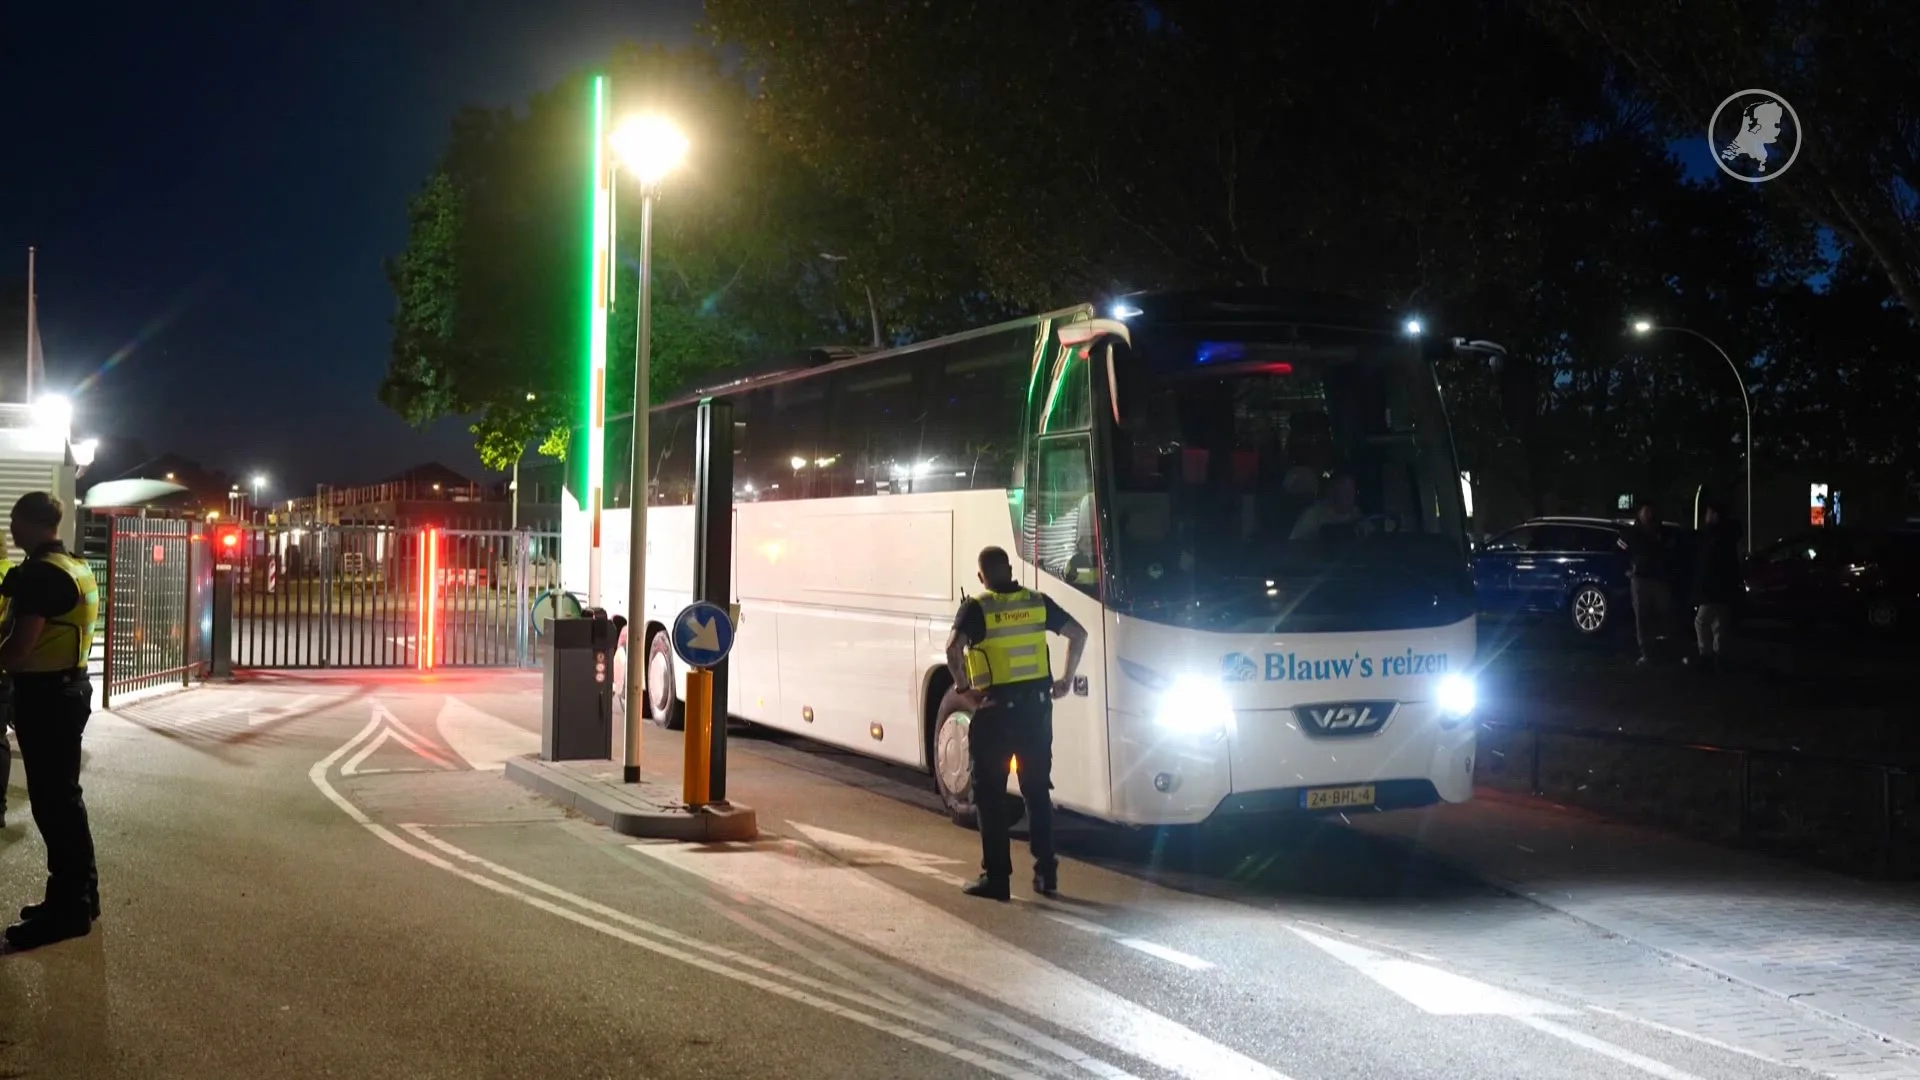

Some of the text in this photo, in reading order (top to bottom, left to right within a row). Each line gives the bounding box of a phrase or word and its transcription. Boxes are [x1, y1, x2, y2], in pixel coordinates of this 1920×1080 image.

[1264, 647, 1448, 681] Blauw's reizen
[1310, 707, 1378, 728] VDL
